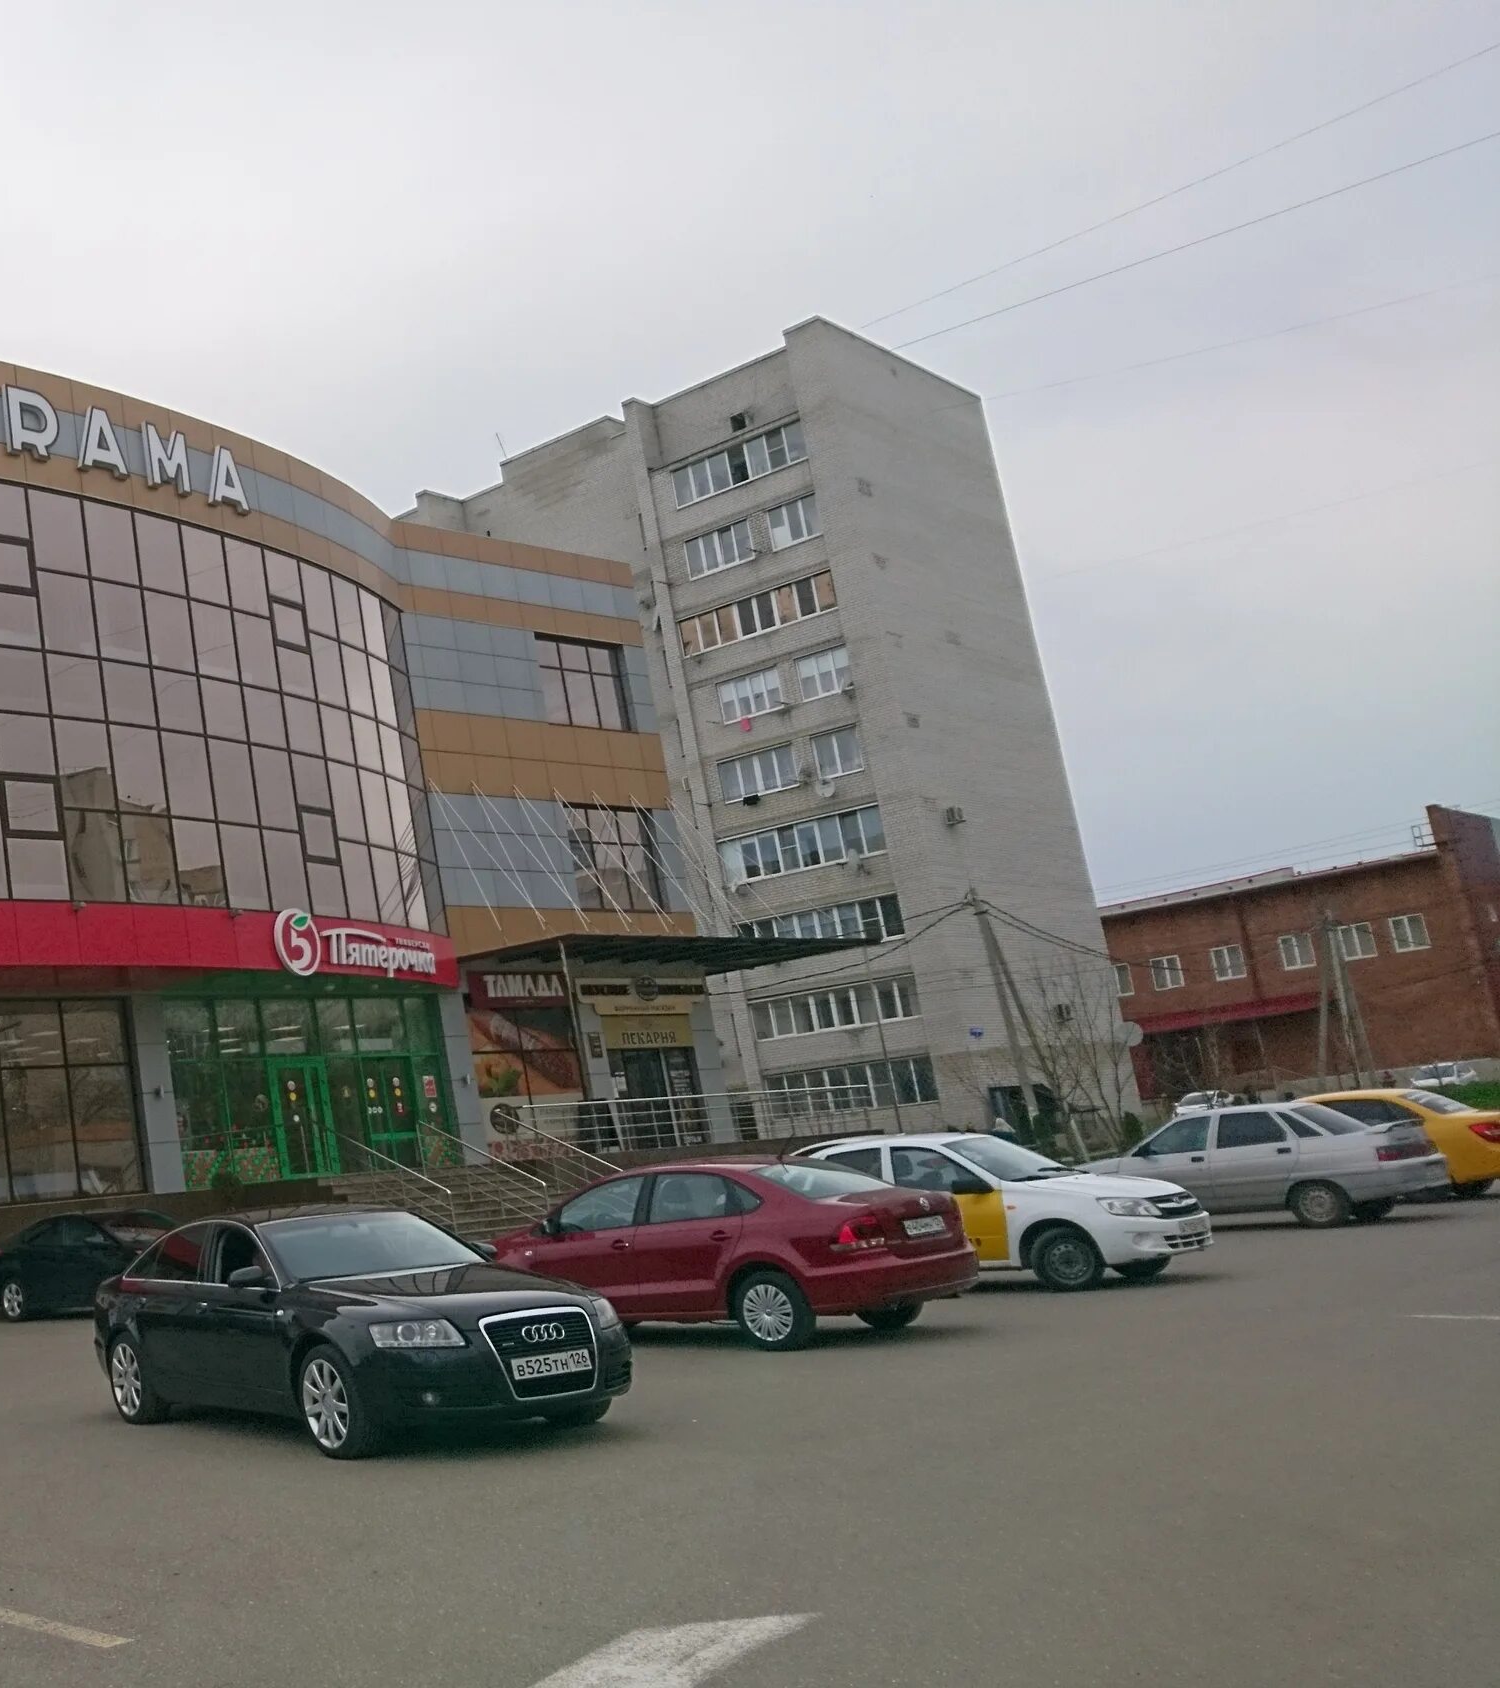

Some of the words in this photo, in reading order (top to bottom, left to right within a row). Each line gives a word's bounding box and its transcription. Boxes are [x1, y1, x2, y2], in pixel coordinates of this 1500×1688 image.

[483, 974, 564, 998] ТАМАДА
[621, 1031, 677, 1045] ПЕКАРНЯ
[569, 1351, 587, 1365] 126
